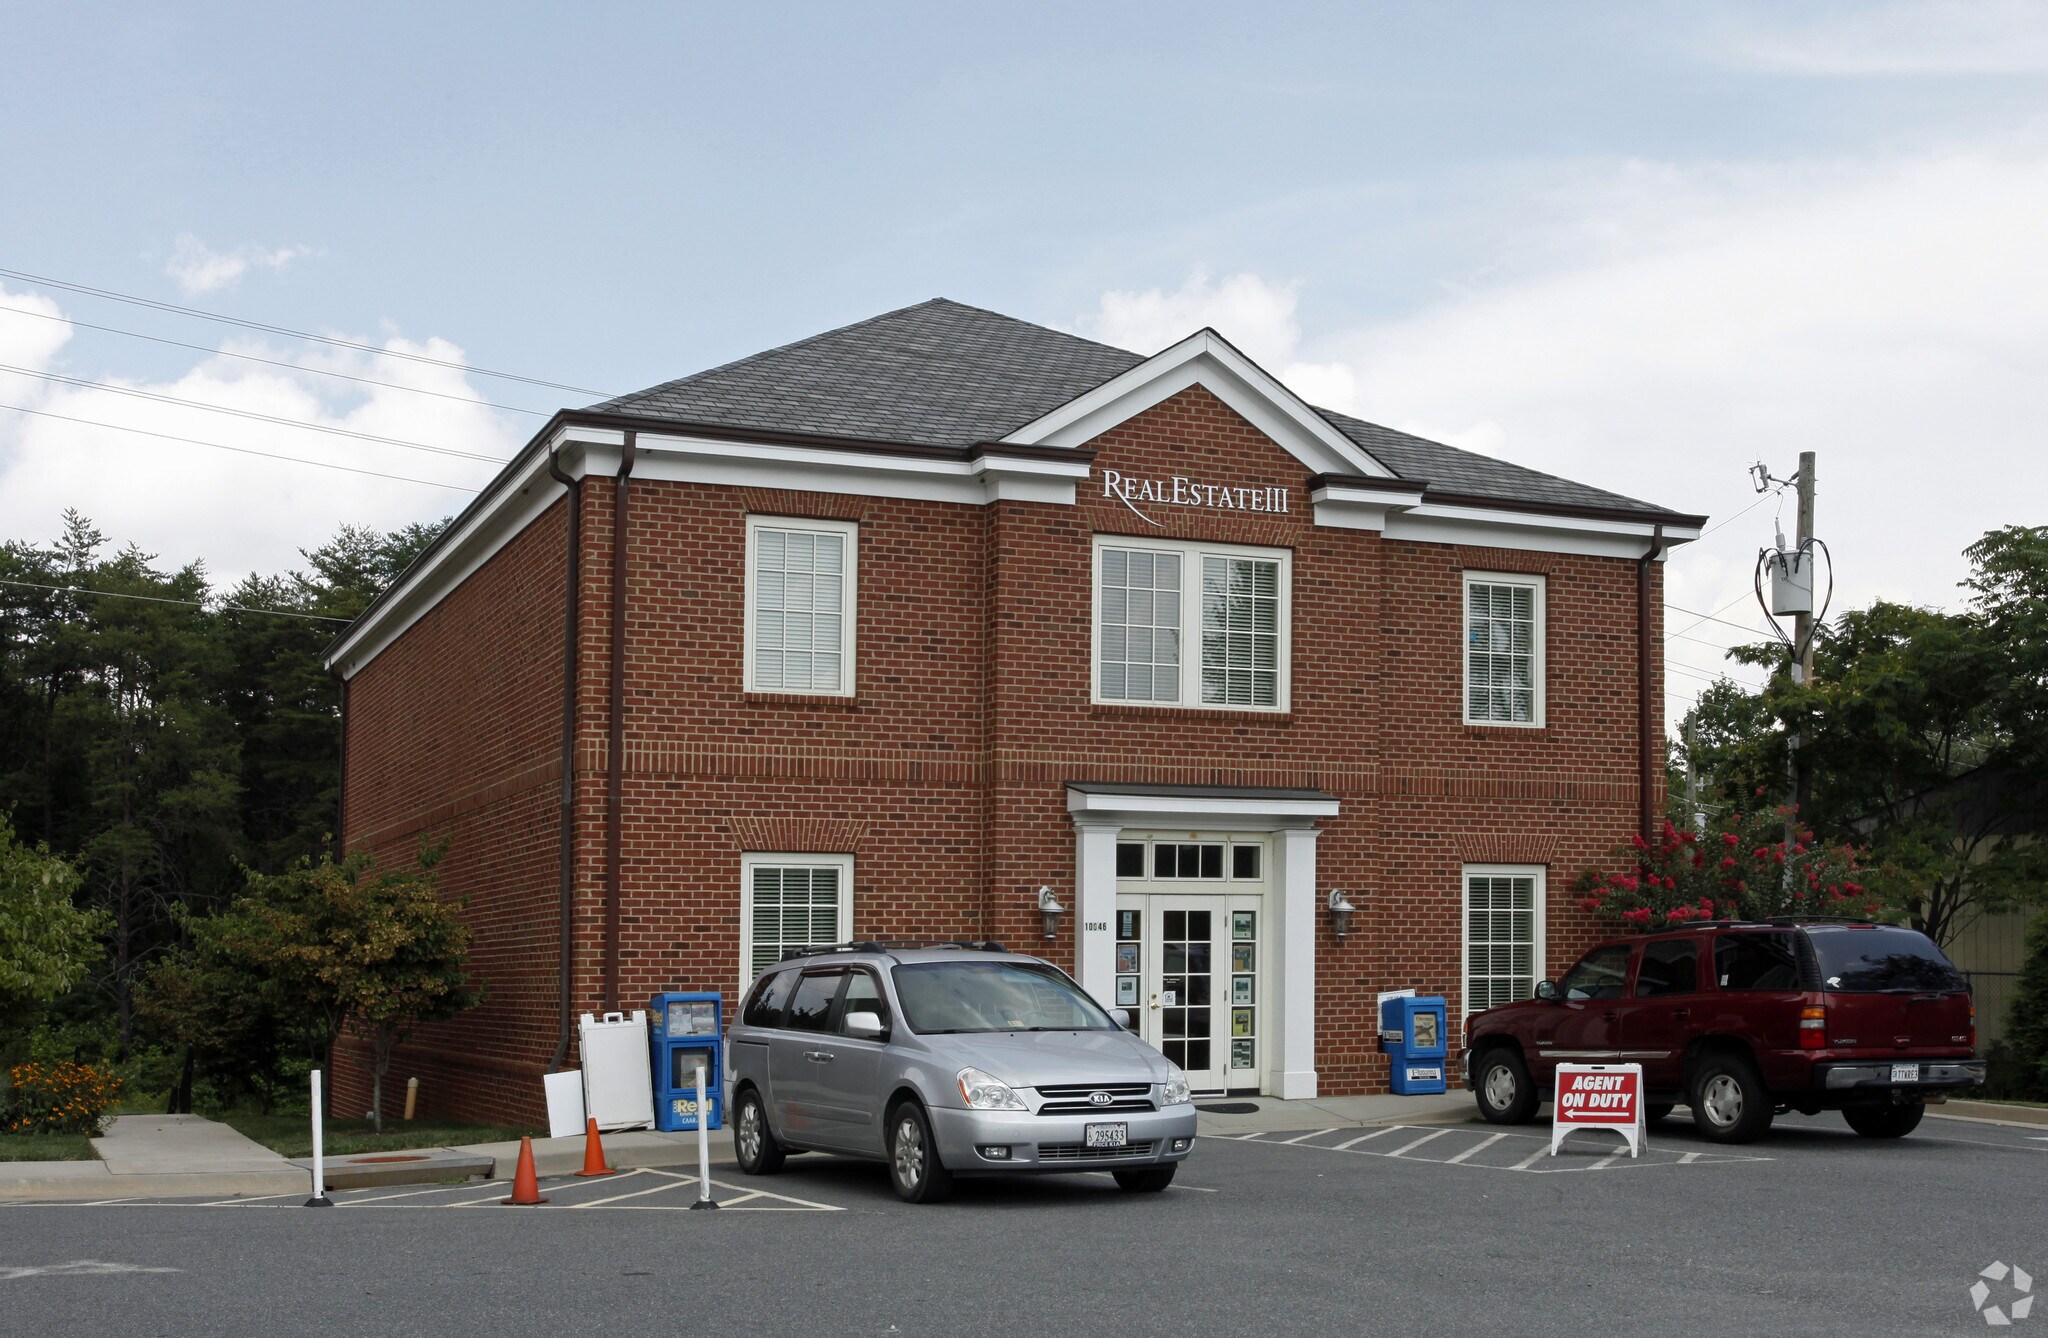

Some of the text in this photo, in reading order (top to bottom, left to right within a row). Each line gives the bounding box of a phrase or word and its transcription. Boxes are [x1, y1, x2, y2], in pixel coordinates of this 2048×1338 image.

[1571, 1075, 1625, 1091] AGENT
[678, 1098, 713, 1112] Rel
[1093, 1094, 1110, 1102] KIA
[1561, 1092, 1633, 1108] ON DUTY
[1095, 1129, 1125, 1141] 295433
